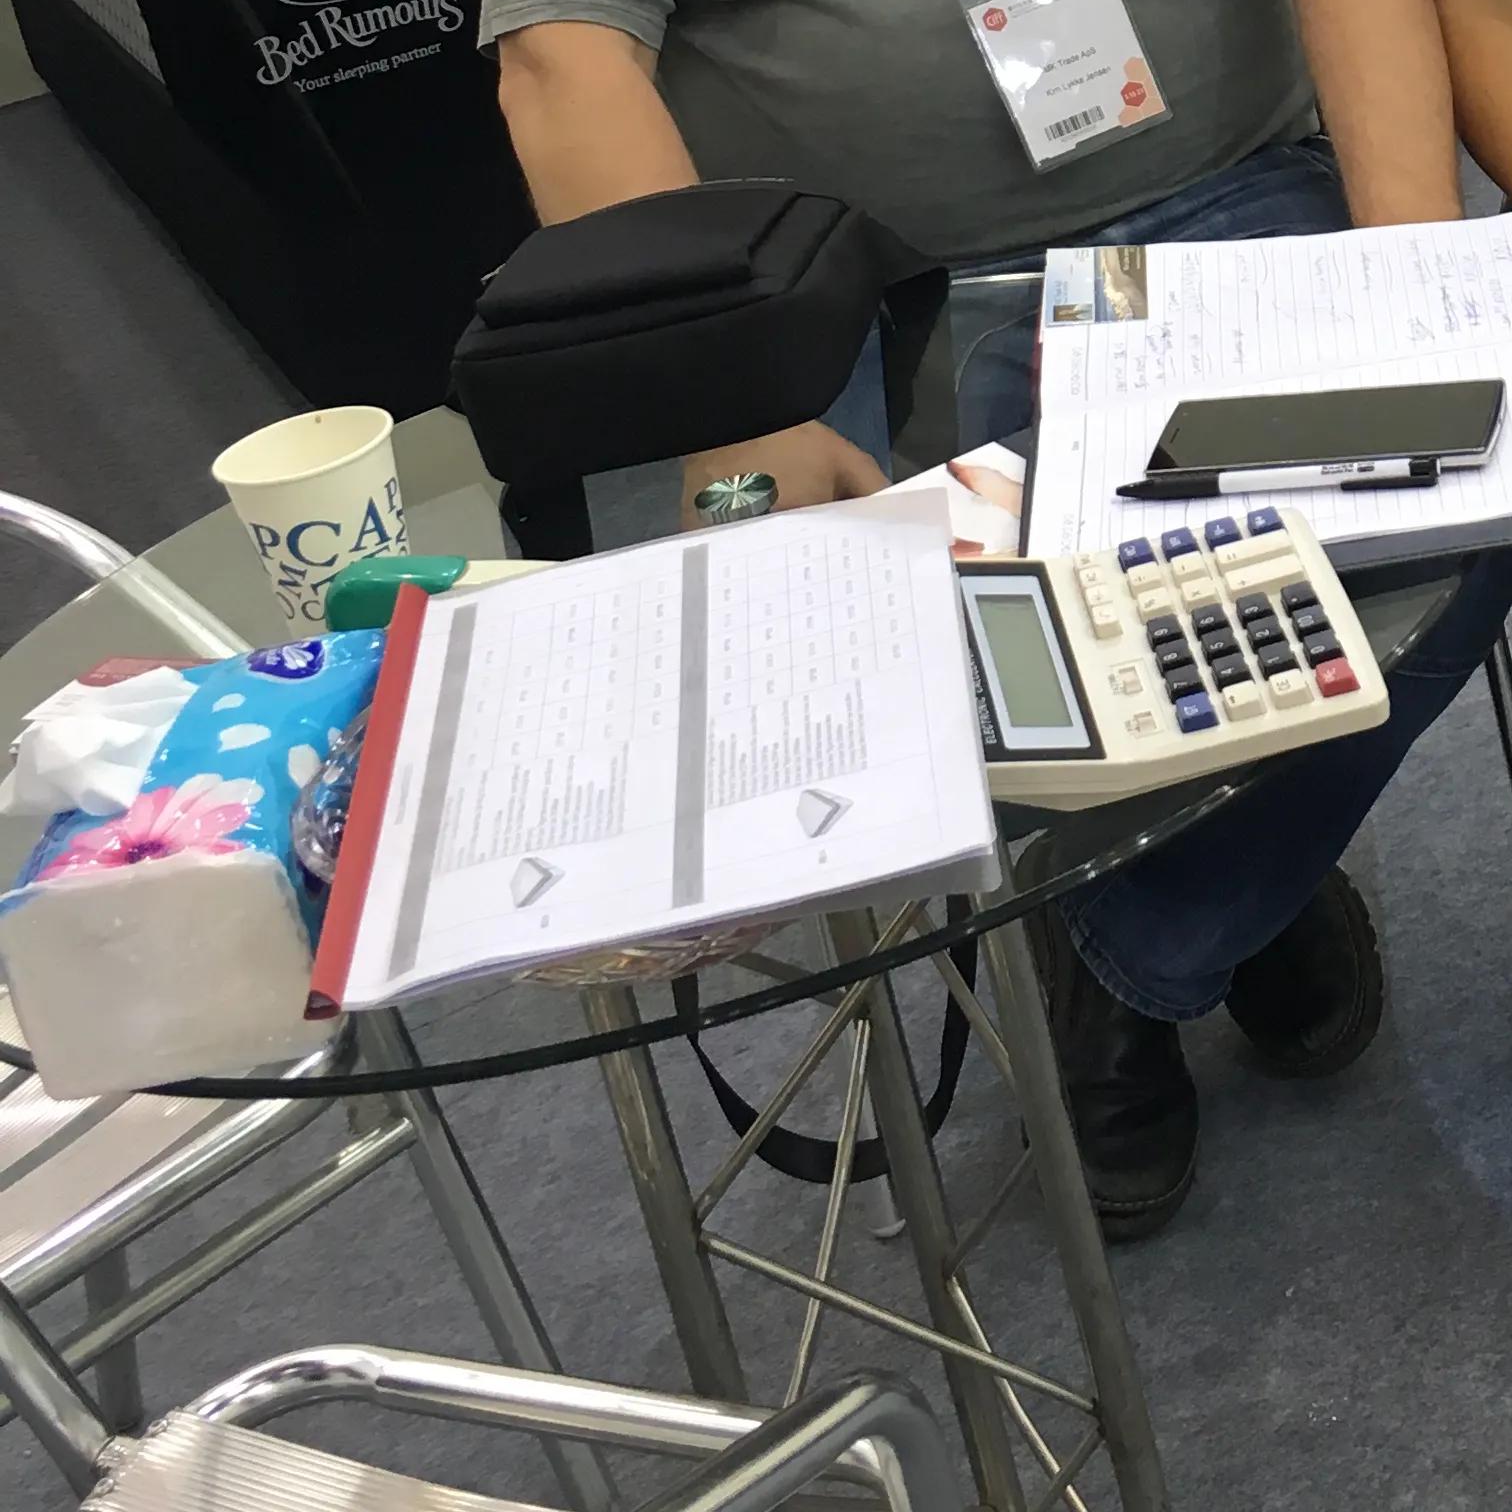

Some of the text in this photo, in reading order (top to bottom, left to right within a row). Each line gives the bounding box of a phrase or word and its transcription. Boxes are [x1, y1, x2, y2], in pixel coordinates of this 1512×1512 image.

[253, 20, 324, 85] Bed
[294, 42, 442, 93] Your sleeping partner
